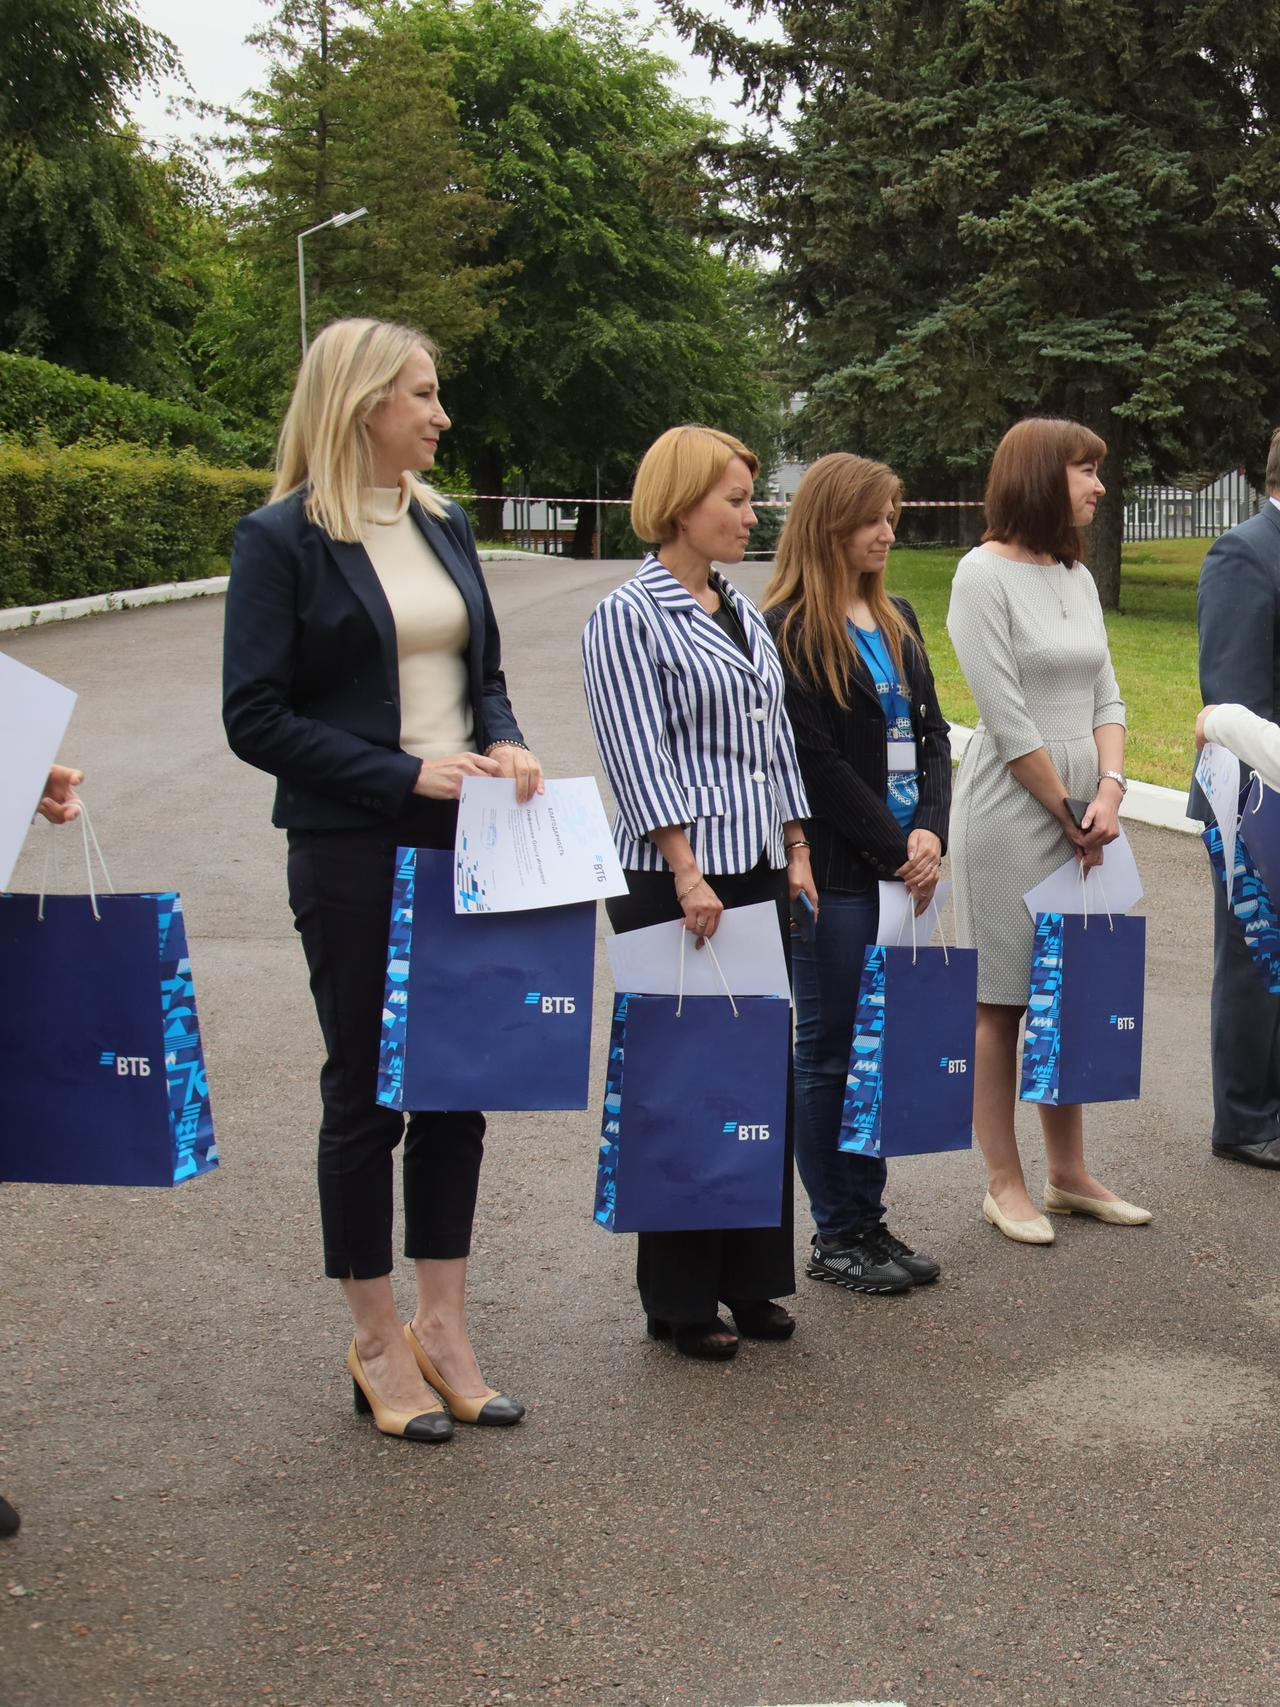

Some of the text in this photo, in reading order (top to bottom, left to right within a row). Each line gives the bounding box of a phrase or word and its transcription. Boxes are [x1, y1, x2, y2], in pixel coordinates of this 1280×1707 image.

[593, 864, 606, 882] ВТБ
[541, 996, 575, 1014] ВТБ
[1117, 1017, 1135, 1030] ВТБ
[117, 1057, 150, 1076] ВТБ
[948, 1059, 966, 1073] ВТБ
[738, 1124, 770, 1141] ВТБ
